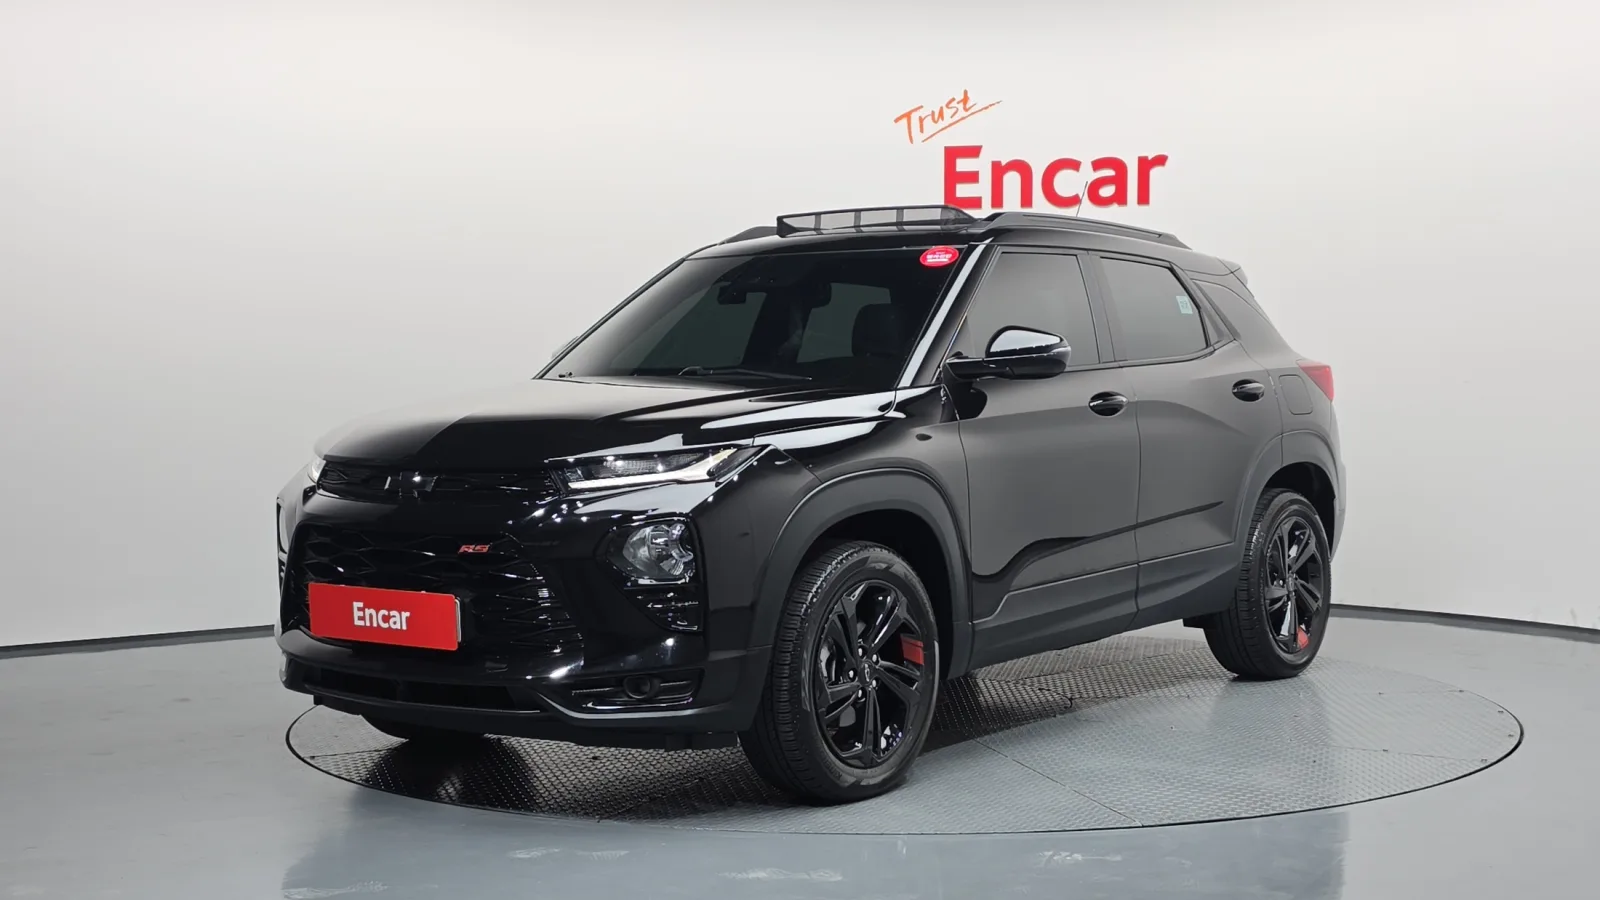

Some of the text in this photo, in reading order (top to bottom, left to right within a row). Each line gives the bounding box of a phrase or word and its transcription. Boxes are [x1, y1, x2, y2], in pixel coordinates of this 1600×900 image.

[894, 89, 977, 144] Trust
[944, 145, 1169, 209] Encar
[459, 544, 490, 553] RS
[352, 601, 410, 630] Encar
